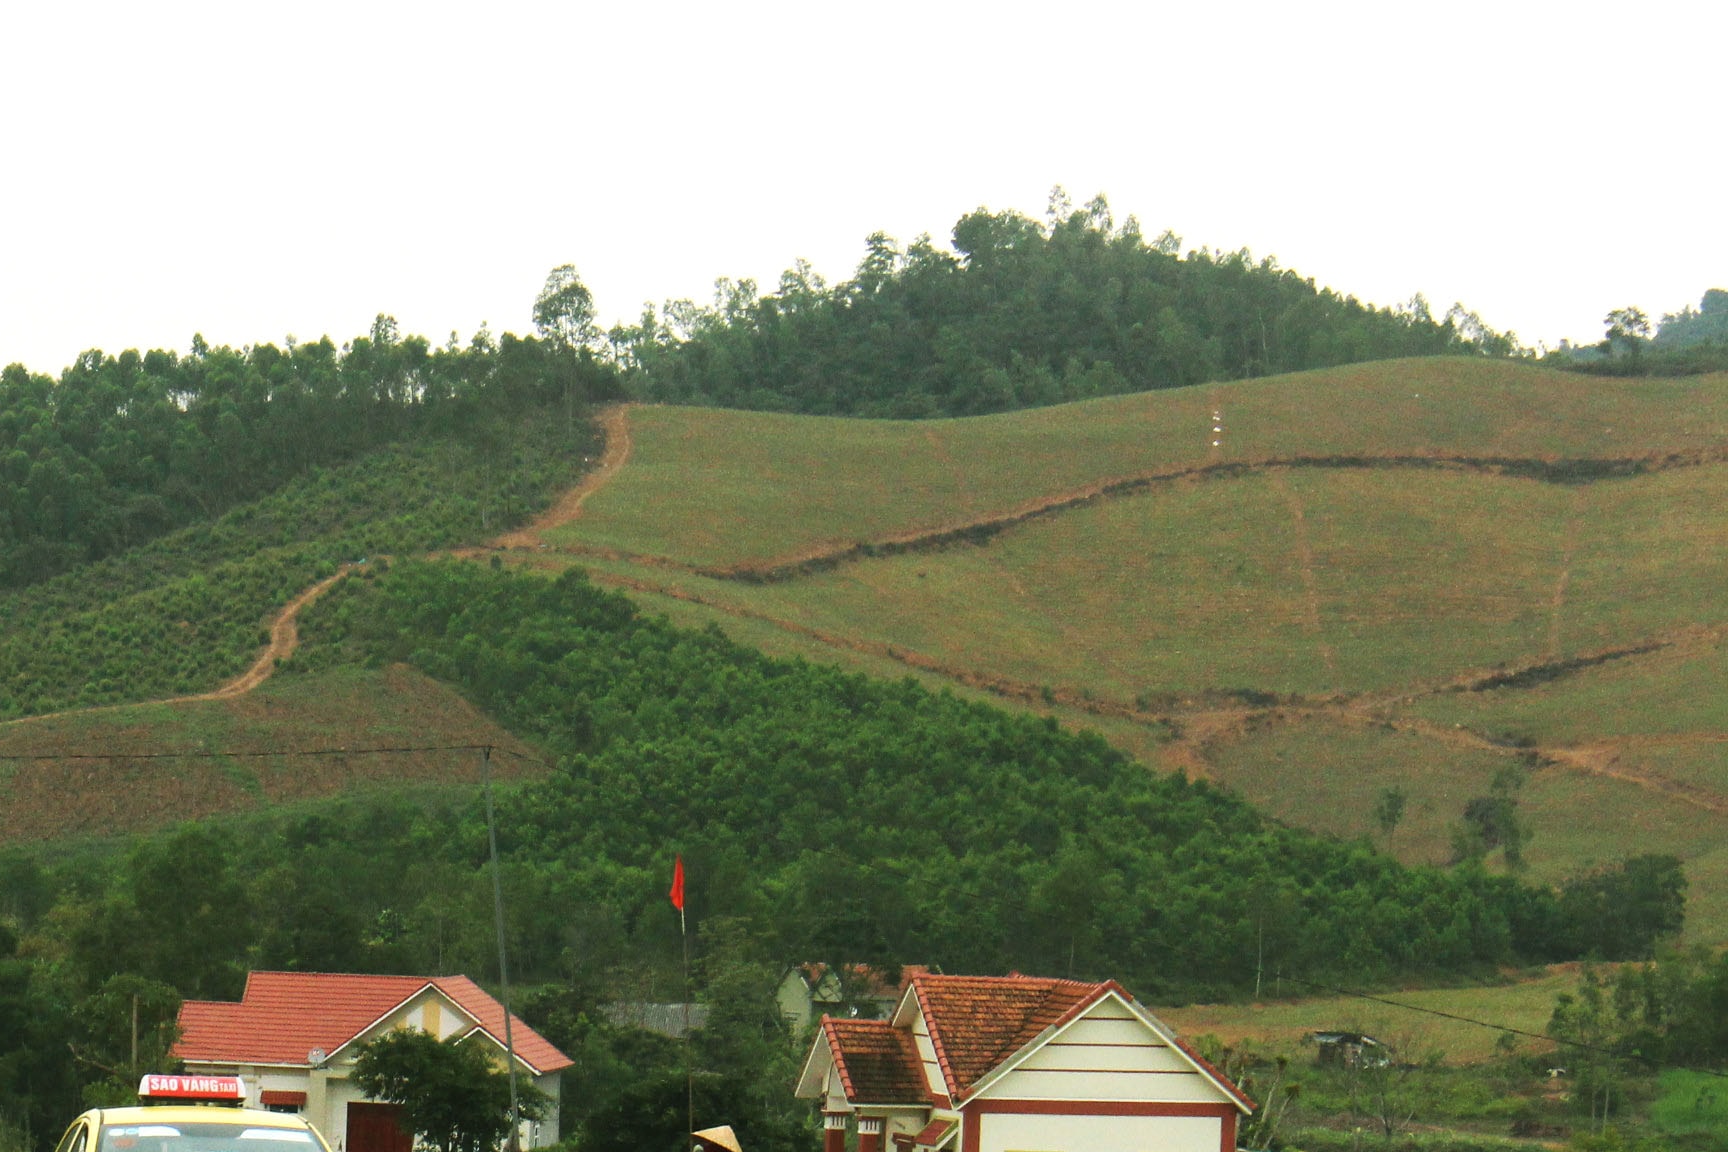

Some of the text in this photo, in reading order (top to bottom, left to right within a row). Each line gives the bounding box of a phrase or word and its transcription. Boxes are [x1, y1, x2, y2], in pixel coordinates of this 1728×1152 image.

[151, 1078, 237, 1092] SAO VANG TAXI
